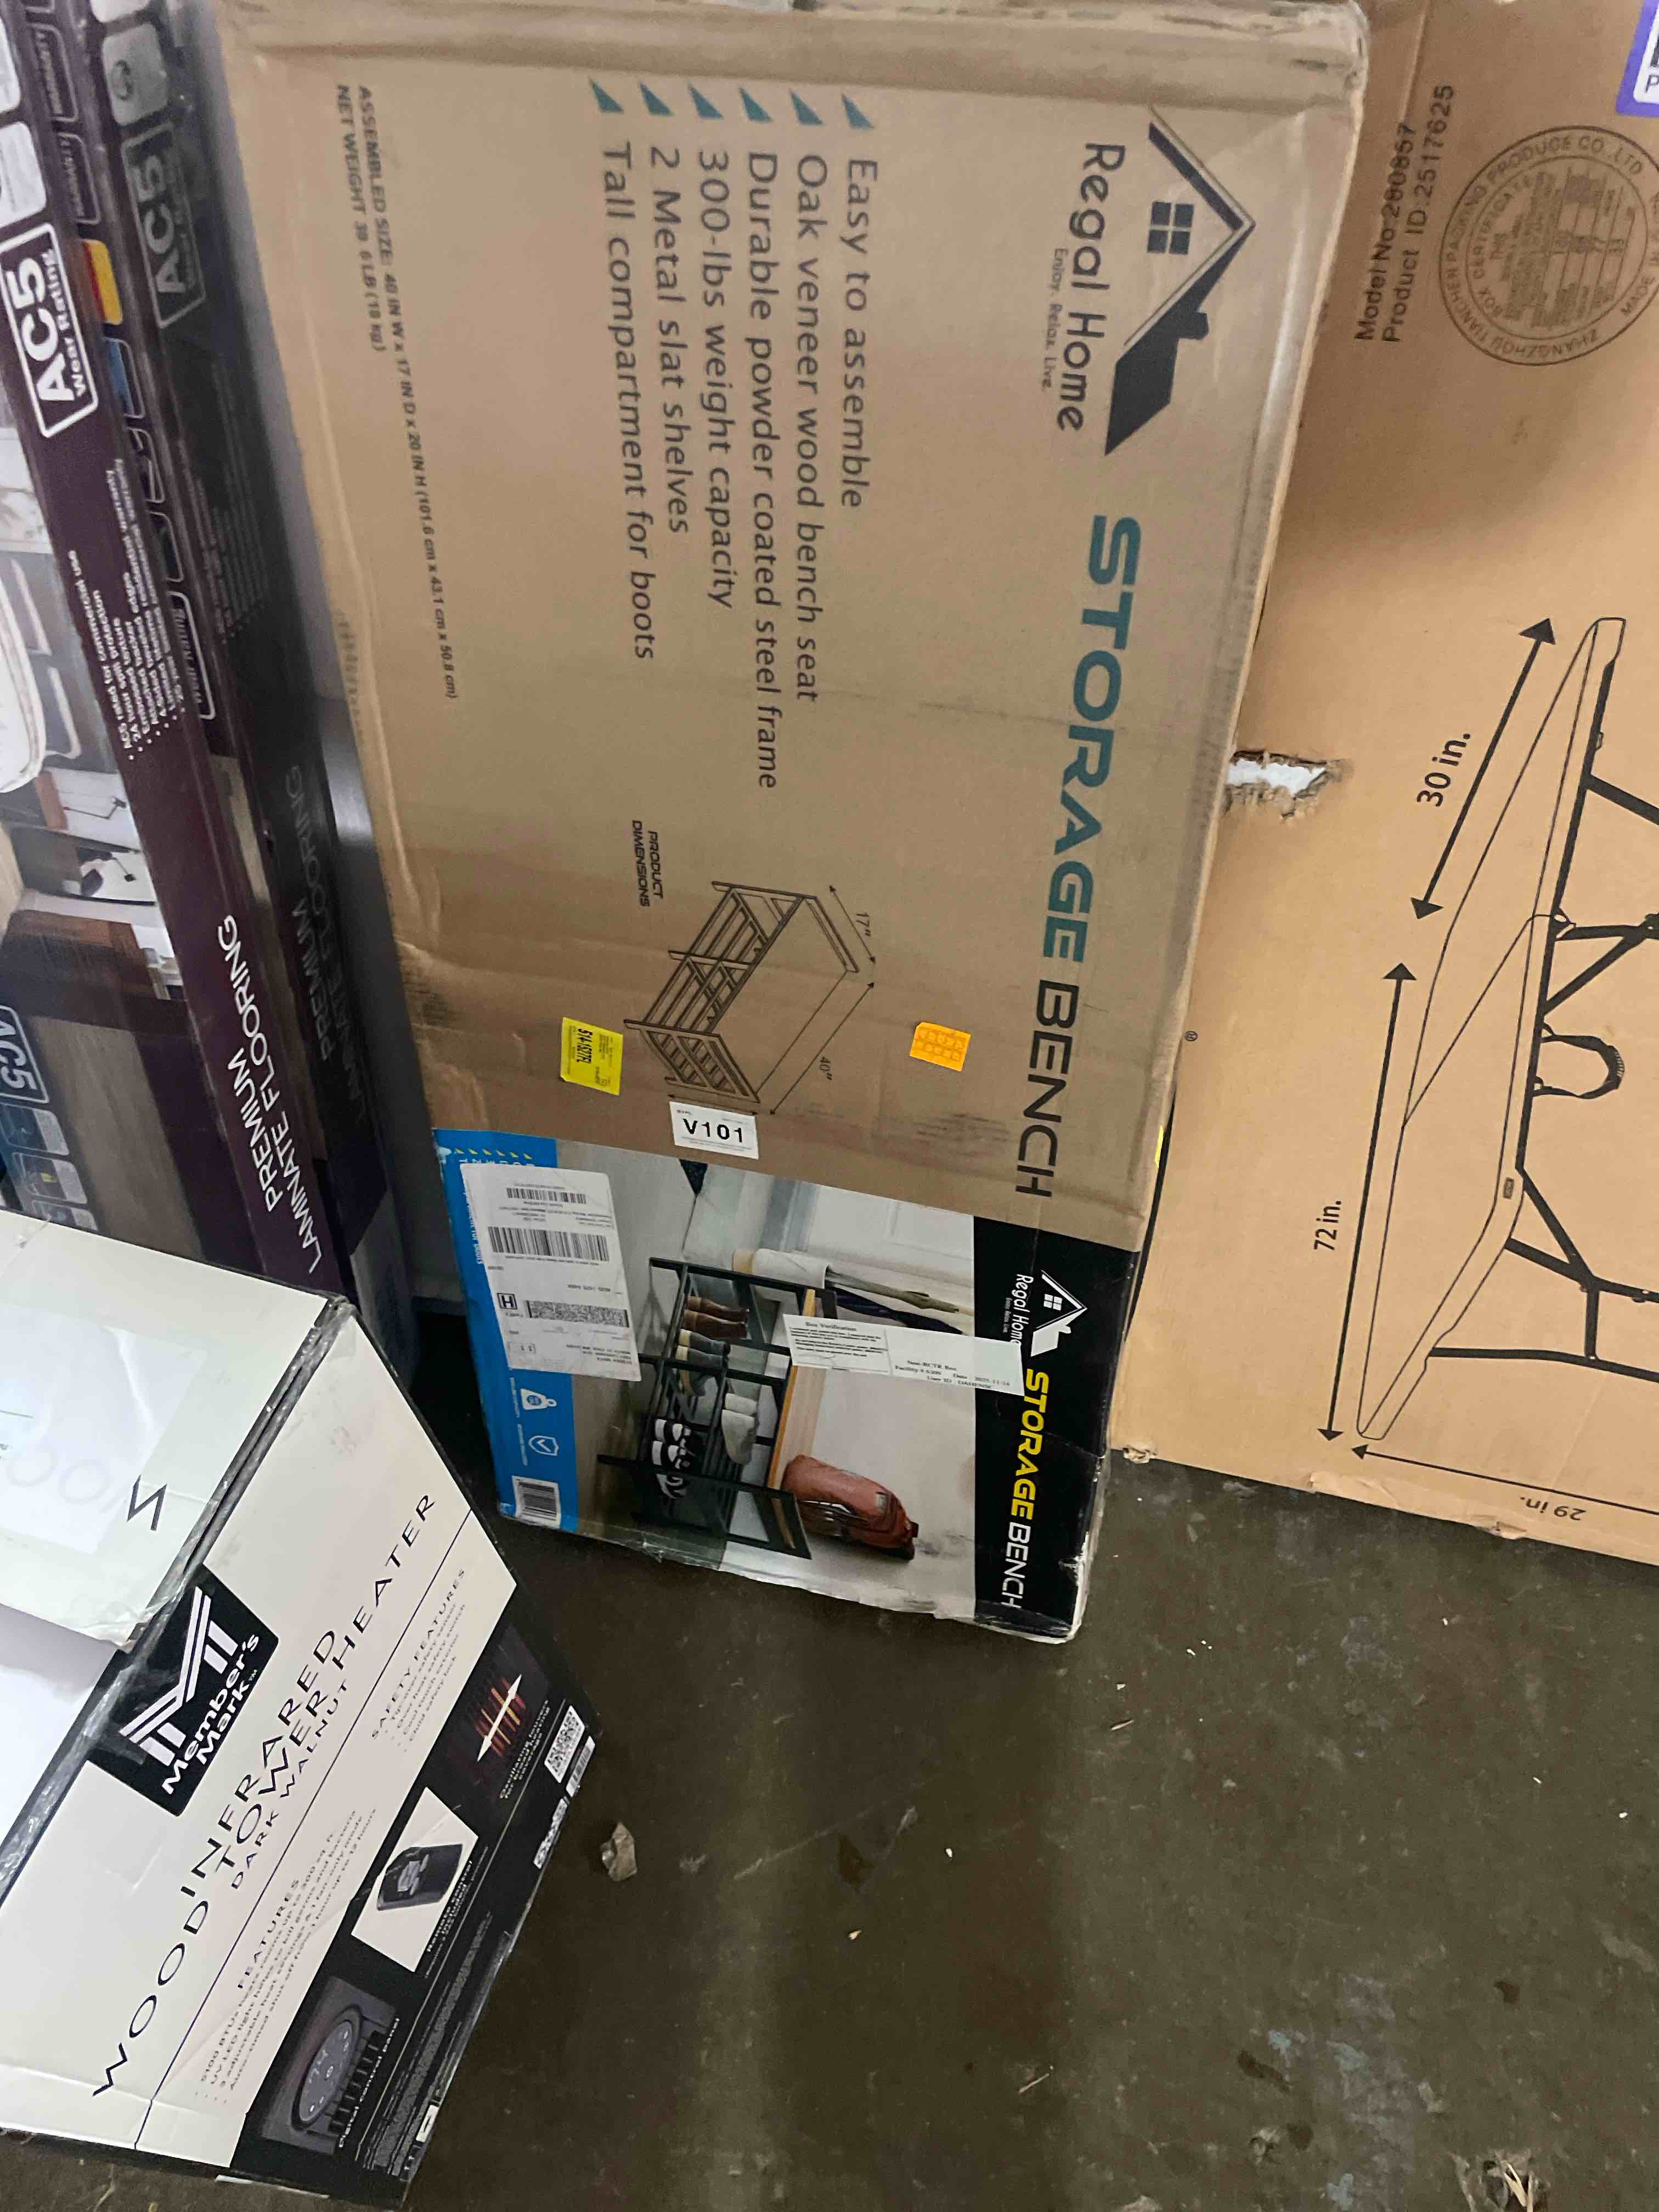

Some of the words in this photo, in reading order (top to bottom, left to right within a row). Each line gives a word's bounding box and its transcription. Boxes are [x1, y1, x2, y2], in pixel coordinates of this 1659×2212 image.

[336, 84, 356, 125] NET
[342, 132, 366, 215] WEIGHT
[357, 84, 388, 213] ASSEMBLED
[602, 141, 635, 219] Tall
[650, 146, 681, 168] 2
[138, 154, 187, 295] AC5
[698, 151, 732, 308] 300-lbs
[747, 153, 779, 320] Durable
[797, 154, 827, 240] Oak
[840, 159, 878, 255] Easy
[1068, 143, 1126, 291] Regal
[653, 190, 686, 302] Metal
[14, 258, 75, 402] AC5
[44, 249, 74, 336] Rating
[797, 257, 819, 395] veneer
[844, 272, 870, 312] to
[1353, 272, 1386, 341] Model
[1381, 249, 1420, 341] Product
[63, 341, 86, 396] Wear
[607, 236, 646, 498] compartment
[658, 319, 689, 388] slat
[700, 324, 736, 453] weight
[1057, 312, 1105, 432] Home
[744, 337, 780, 479] powder
[841, 328, 870, 507] assemble
[662, 403, 693, 533] shelves
[797, 409, 825, 507] wood
[67, 549, 81, 577] use
[627, 510, 653, 558] for
[706, 468, 738, 610] capacity
[753, 492, 782, 607] coated
[797, 522, 825, 623] bench
[77, 578, 104, 663] commercial
[93, 588, 116, 660] protection
[121, 571, 138, 614] edges
[630, 571, 656, 659] boots
[101, 664, 112, 685] for
[113, 617, 130, 666] texture
[755, 620, 782, 693] steel
[797, 637, 817, 702] seat
[108, 685, 122, 721] rated
[122, 691, 134, 723] hour
[127, 666, 149, 735] Embossed
[131, 723, 140, 742] 24
[1043, 515, 1141, 962] STORAGE
[758, 704, 783, 789] frame
[1417, 770, 1452, 808] 30
[1433, 732, 1471, 770] in.
[632, 820, 650, 907] DIMENSIONS
[648, 831, 663, 899] PRODUCT
[217, 915, 281, 1113] FLOORING
[291, 897, 336, 1061] PREMIUM
[228, 1047, 284, 1211] PREMIUM
[682, 1118, 742, 1143] V101
[1015, 980, 1079, 1198] BENCH
[271, 1110, 321, 1274] LAMINATE
[1313, 1221, 1338, 1251] 72
[1327, 1199, 1342, 1219] in.
[1012, 1274, 1034, 1313] Regal
[1011, 1368, 1049, 1520] STORAGE
[1520, 1496, 1551, 1514] in.
[1553, 1504, 1587, 1521] 29
[1000, 1523, 1031, 1610] BENCH
[215, 1690, 328, 1873] TOWER
[333, 1493, 437, 1671] HEATER
[370, 1667, 416, 1739] SAFETY
[407, 1567, 467, 1663] FEATURES
[161, 1633, 259, 1795] Member's
[230, 1809, 281, 1890] DARK
[279, 1679, 353, 1798] WALNUT
[93, 1900, 210, 2096] WOOD
[181, 1629, 338, 1898] INFRARED
[236, 1878, 300, 1990] FEATURES
